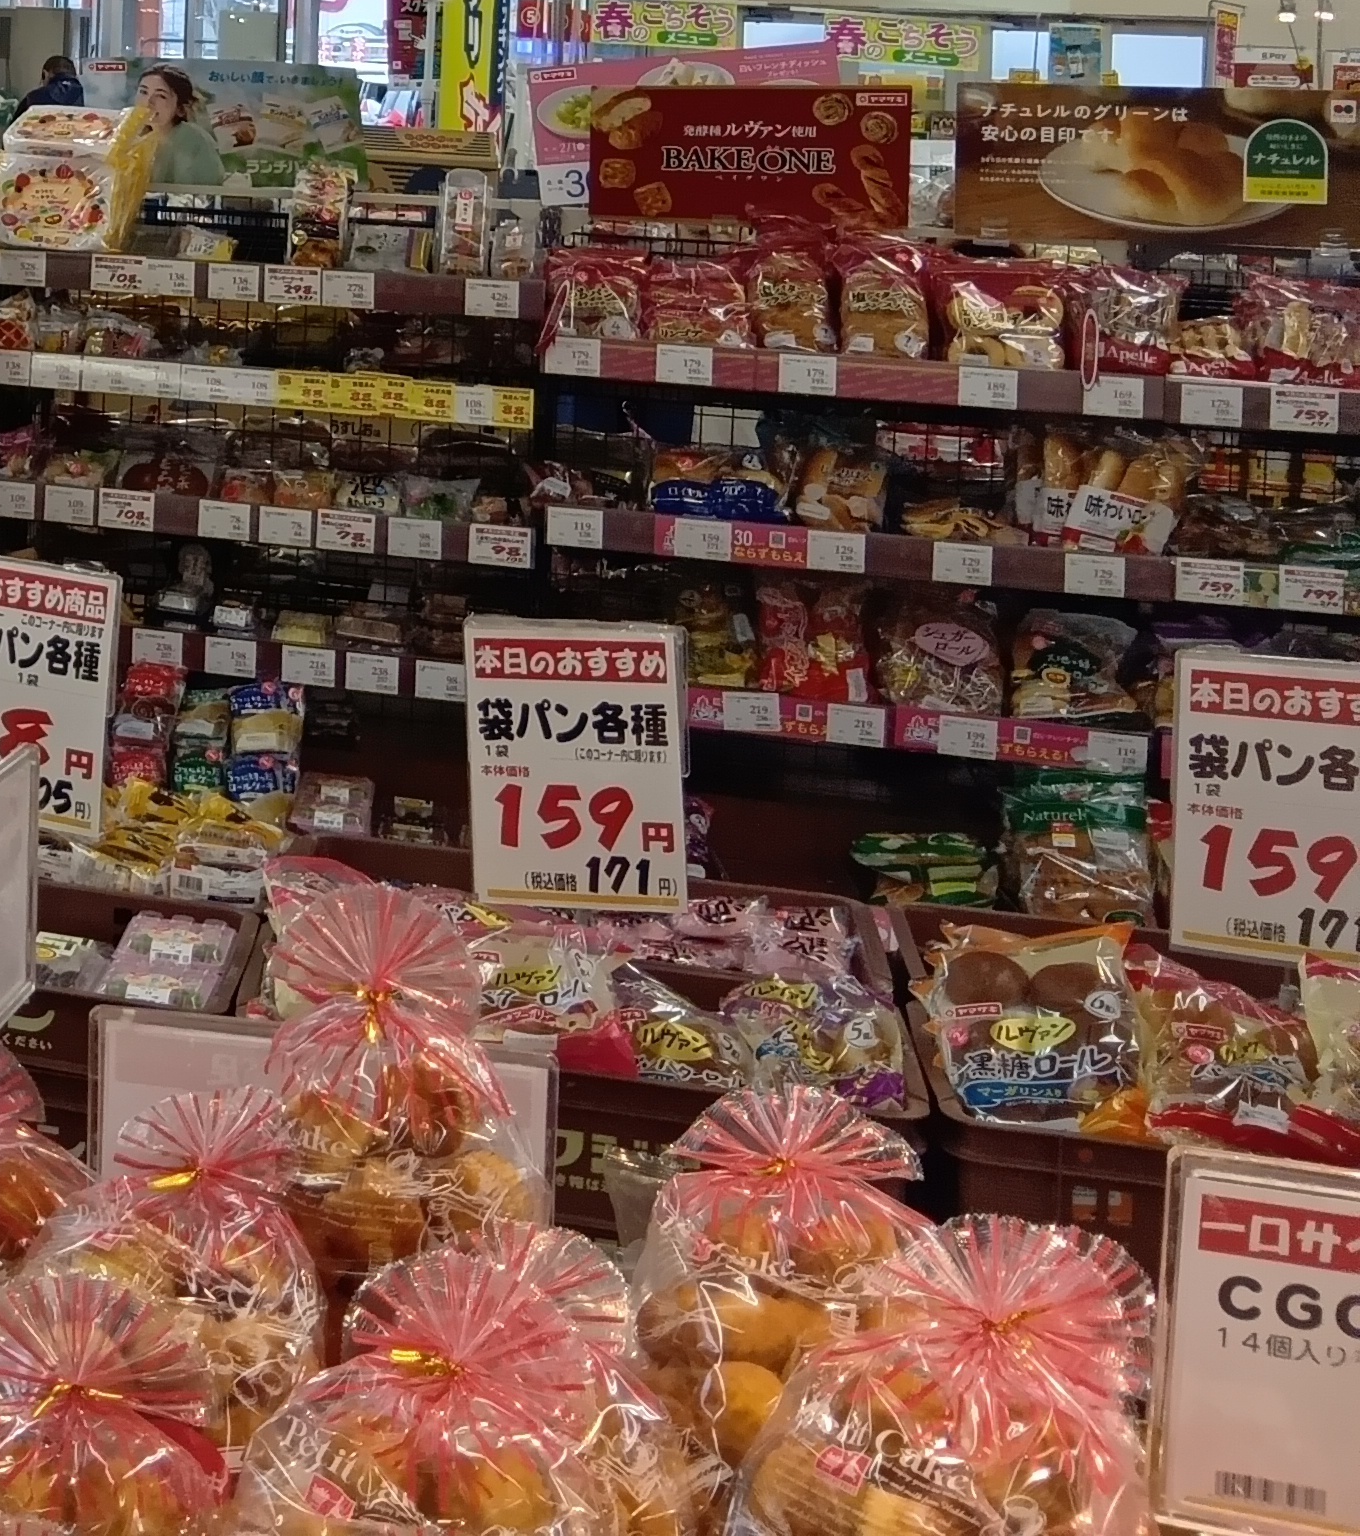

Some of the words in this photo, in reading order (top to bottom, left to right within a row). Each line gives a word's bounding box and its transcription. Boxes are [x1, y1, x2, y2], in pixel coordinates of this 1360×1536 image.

[595, 1, 736, 41] 春のごちそう
[666, 33, 713, 45] メニュー
[901, 50, 951, 65] メニュー
[981, 103, 1188, 122] ナチュレルのグリーンは
[1253, 153, 1320, 167] ナチュレル
[1107, 346, 1158, 365] Apelle
[1293, 410, 1329, 420] 159
[734, 529, 752, 545] 30
[1199, 581, 1233, 593] 159
[1303, 588, 1337, 601] 199
[921, 623, 977, 644] シュガー
[934, 639, 975, 655] ロール
[476, 645, 666, 679] 本日のおすすめ
[17, 672, 39, 687] 1袋
[477, 698, 669, 746] 袋パン各種
[486, 745, 509, 758] 1袋
[1189, 733, 1360, 792] 袋パン各
[481, 765, 530, 778] 本体価格
[1194, 782, 1221, 797] 1袋
[1187, 803, 1243, 820] 本体価格
[1200, 825, 1359, 903] 159
[641, 1023, 709, 1053] ルヴァン
[996, 1021, 1072, 1045] ルヴァン
[966, 1046, 1113, 1080] 黒糖ロール
[977, 1083, 1063, 1098] マーガリン入り
